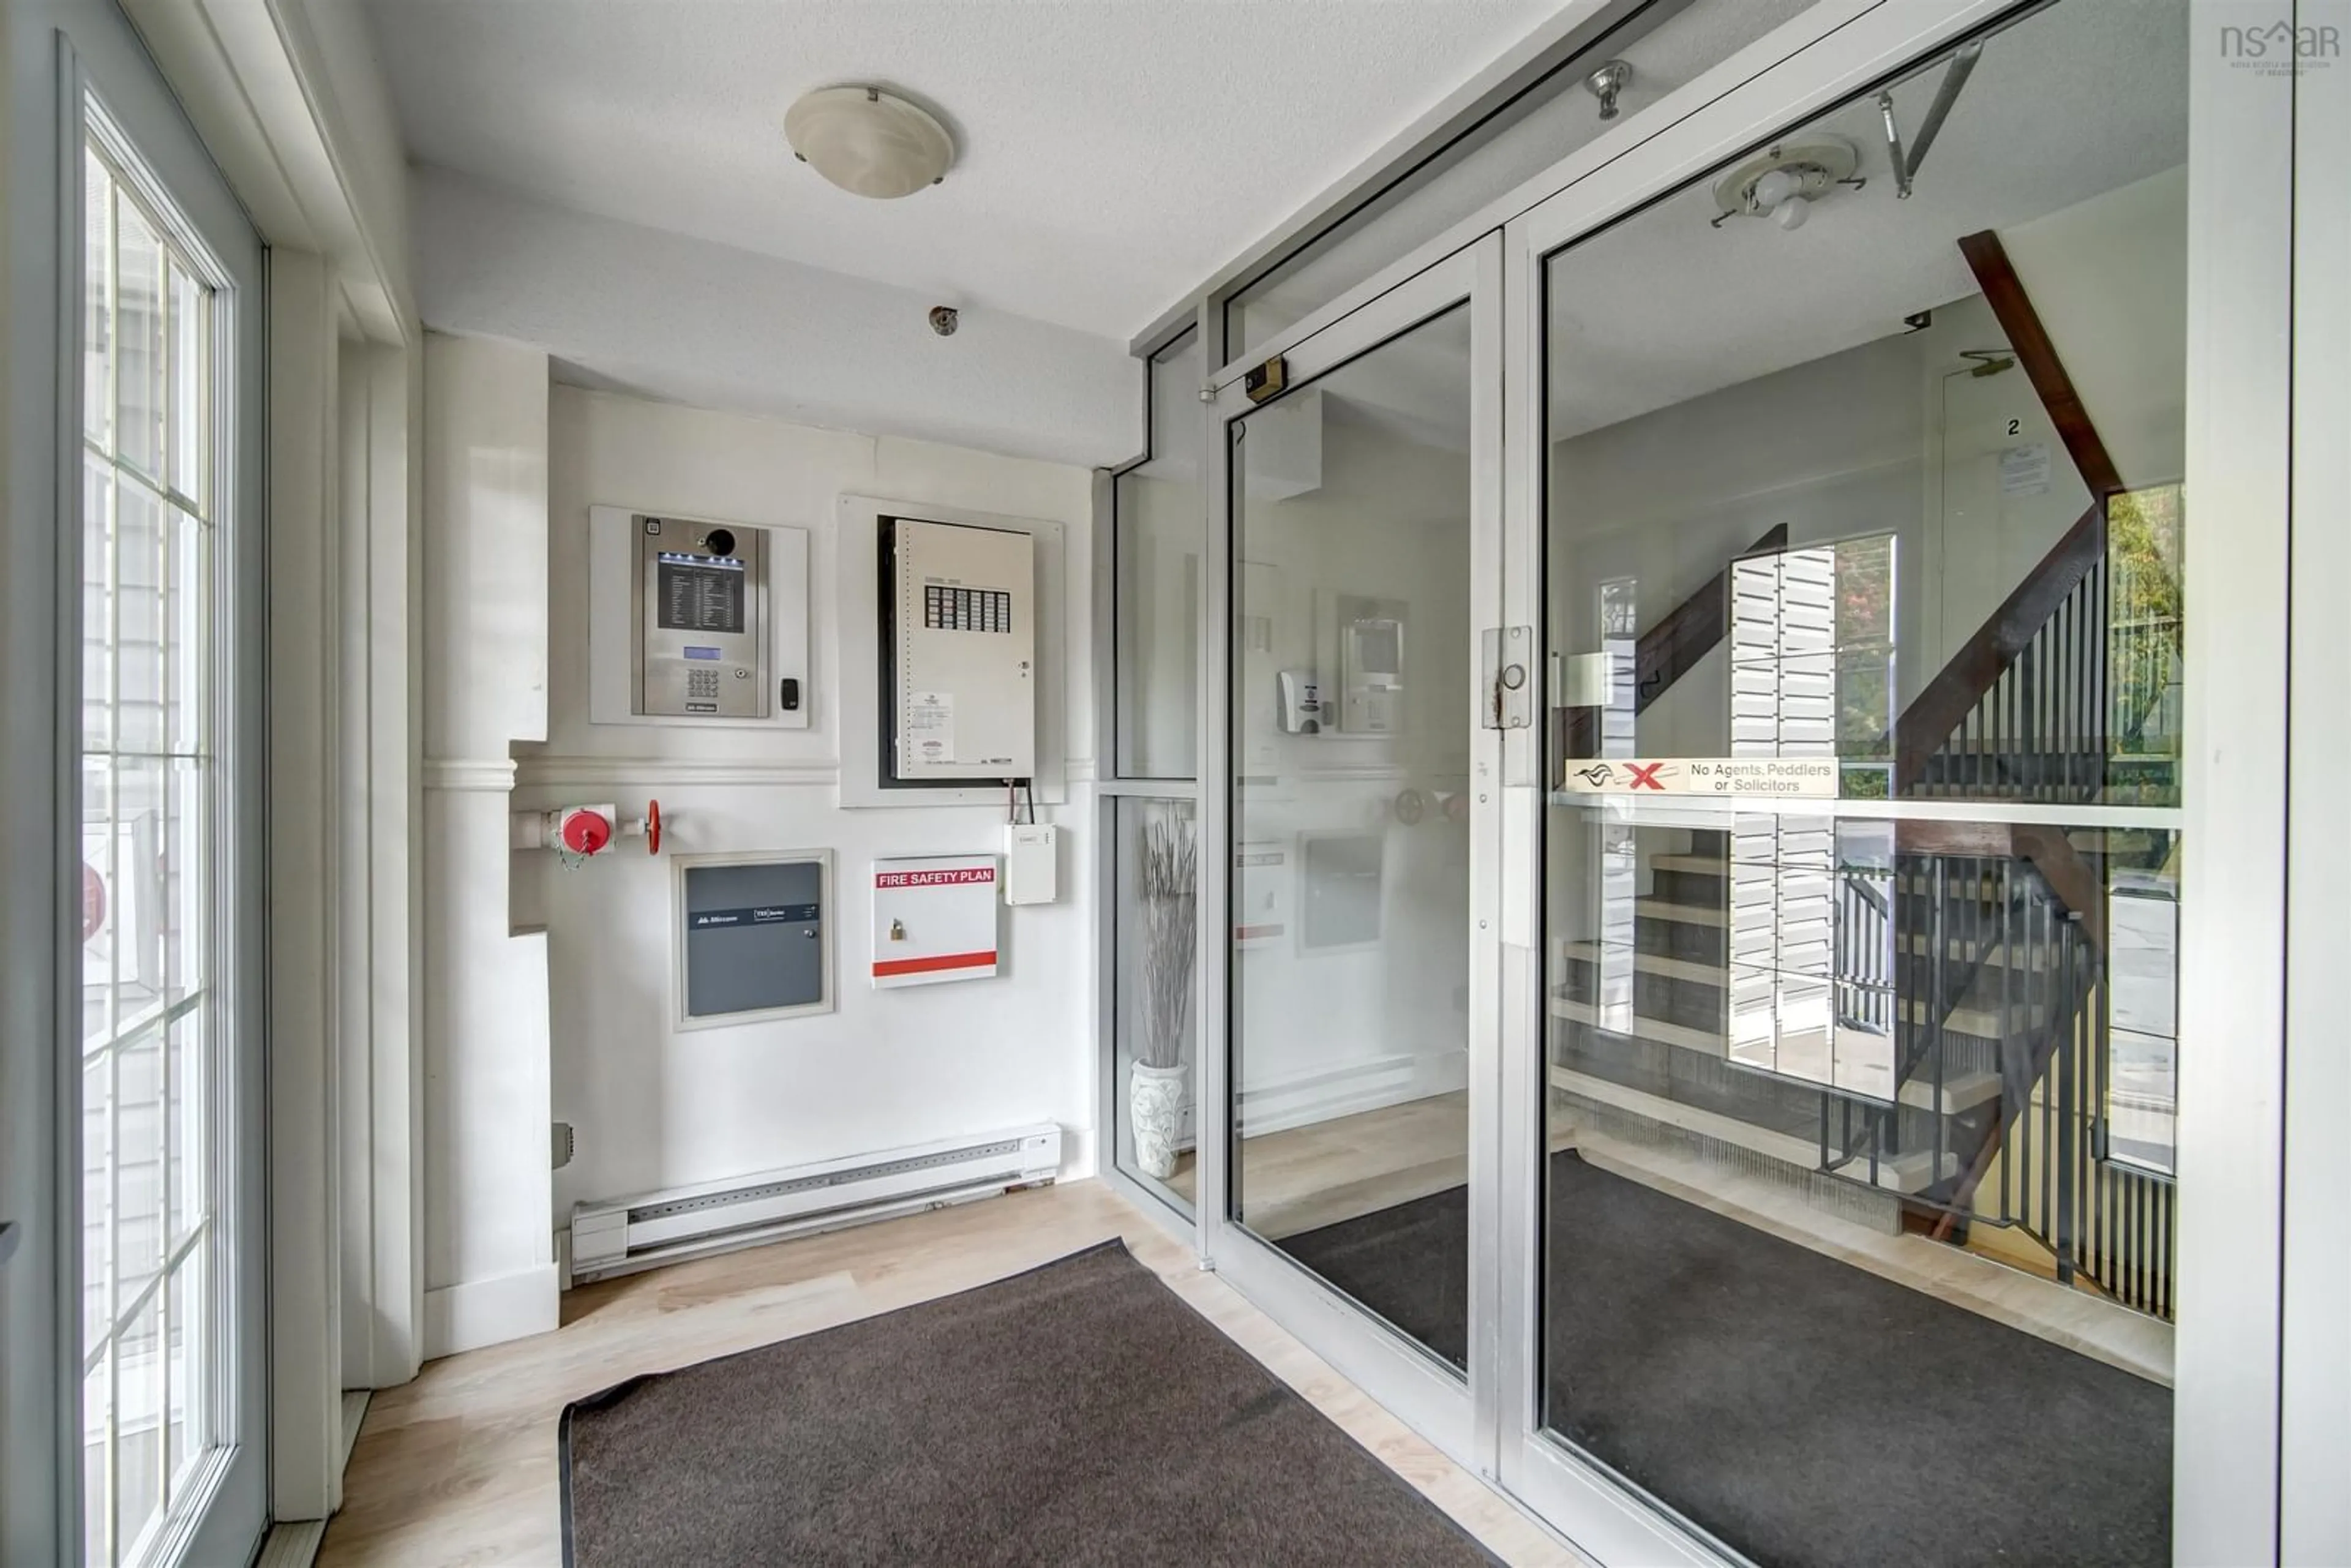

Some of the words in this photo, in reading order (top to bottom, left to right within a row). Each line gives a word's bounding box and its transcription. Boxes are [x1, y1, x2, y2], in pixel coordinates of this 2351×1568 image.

[2008, 419, 2019, 435] 2
[1691, 764, 1709, 775] No
[1768, 763, 1831, 776] Peddlers
[1715, 781, 1728, 790] or
[1734, 779, 1799, 792] Solicitors
[879, 874, 907, 887] FIRE
[910, 871, 958, 884] SAFETY
[960, 869, 991, 881] PLAN
